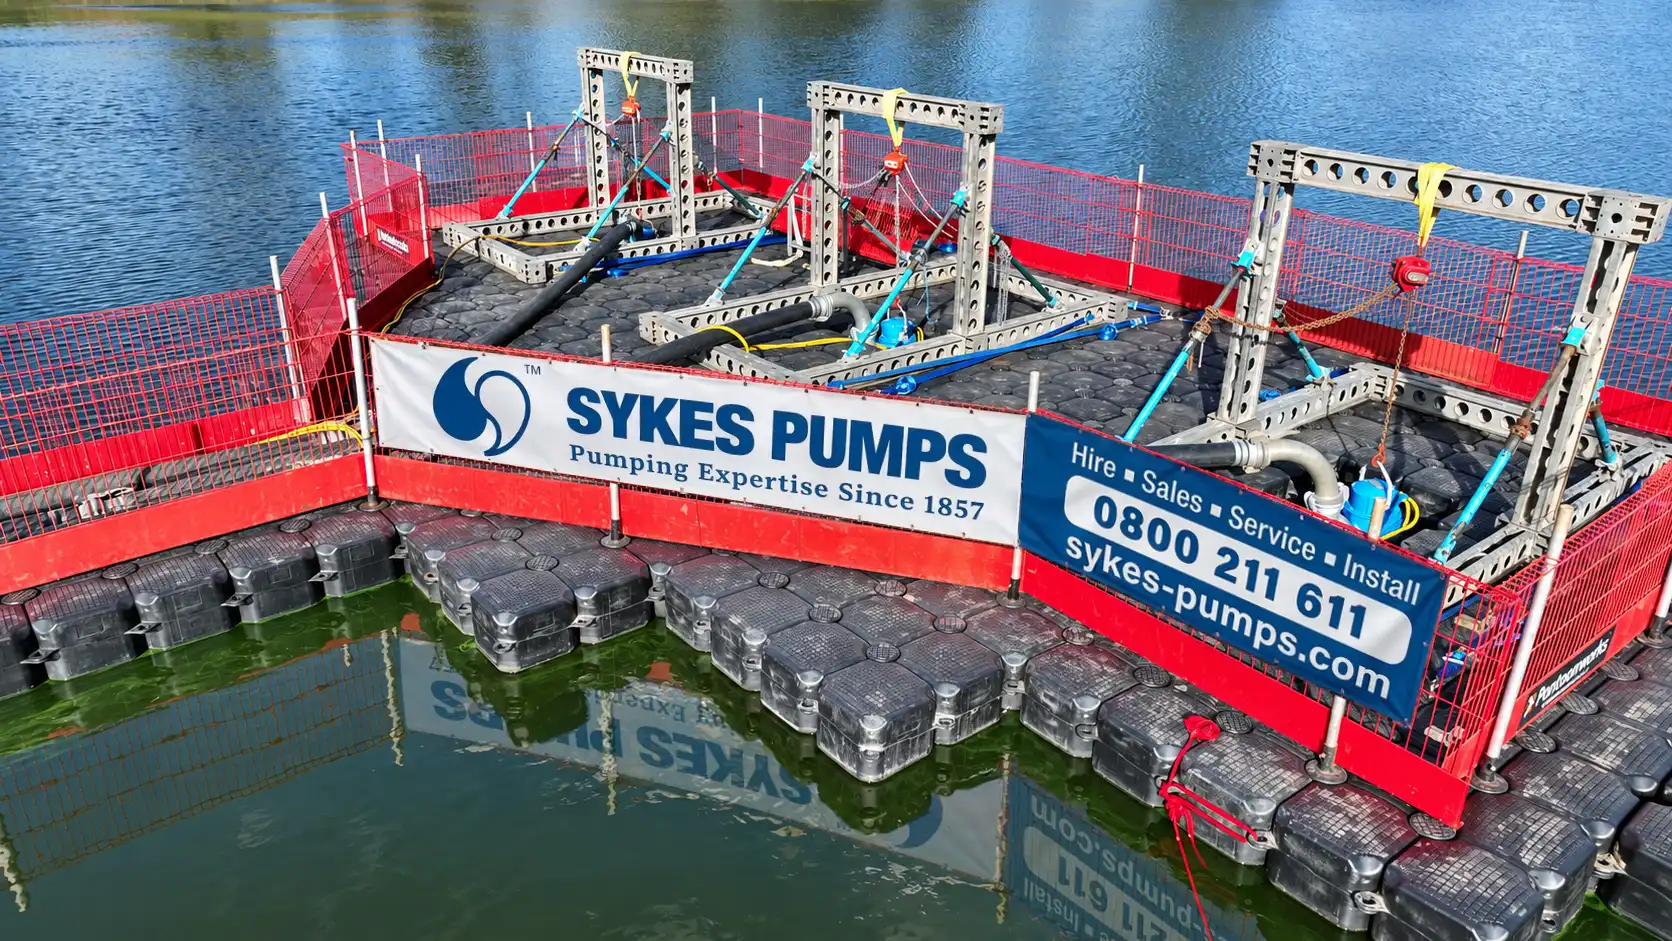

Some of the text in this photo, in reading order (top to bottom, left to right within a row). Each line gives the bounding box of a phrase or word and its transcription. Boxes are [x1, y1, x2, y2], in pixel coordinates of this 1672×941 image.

[523, 364, 541, 376] TM
[566, 387, 987, 489] SYKES PUMPS
[569, 444, 985, 521] Pumping Expertise Since 1857
[1071, 441, 1421, 606] Hire Sales Service Install
[1093, 494, 1367, 640] 0800 211 611
[1065, 534, 1391, 701] sykes-pumps.com
[1024, 877, 1080, 930] Install
[1057, 855, 1109, 914] 611
